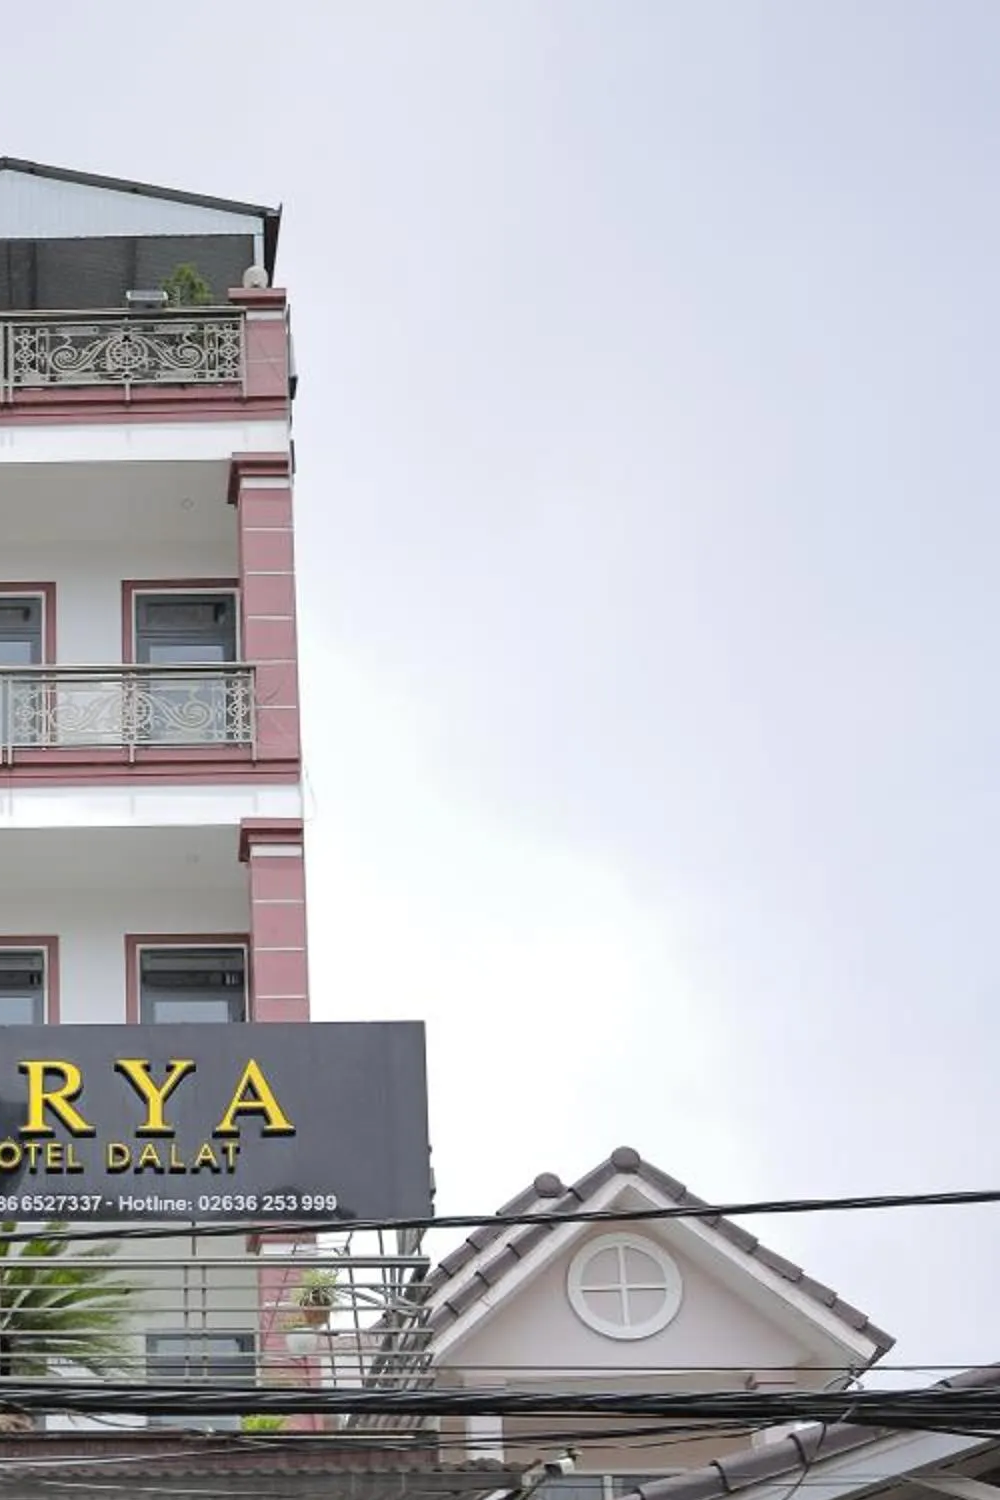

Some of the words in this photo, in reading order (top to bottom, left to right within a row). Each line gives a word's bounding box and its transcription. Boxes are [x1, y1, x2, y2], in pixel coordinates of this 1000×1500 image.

[106, 1142, 240, 1172] DALAT
[119, 1195, 193, 1212] Hotline:
[199, 1195, 257, 1211] 02636
[263, 1195, 298, 1211] 253
[302, 1195, 338, 1211] 999
